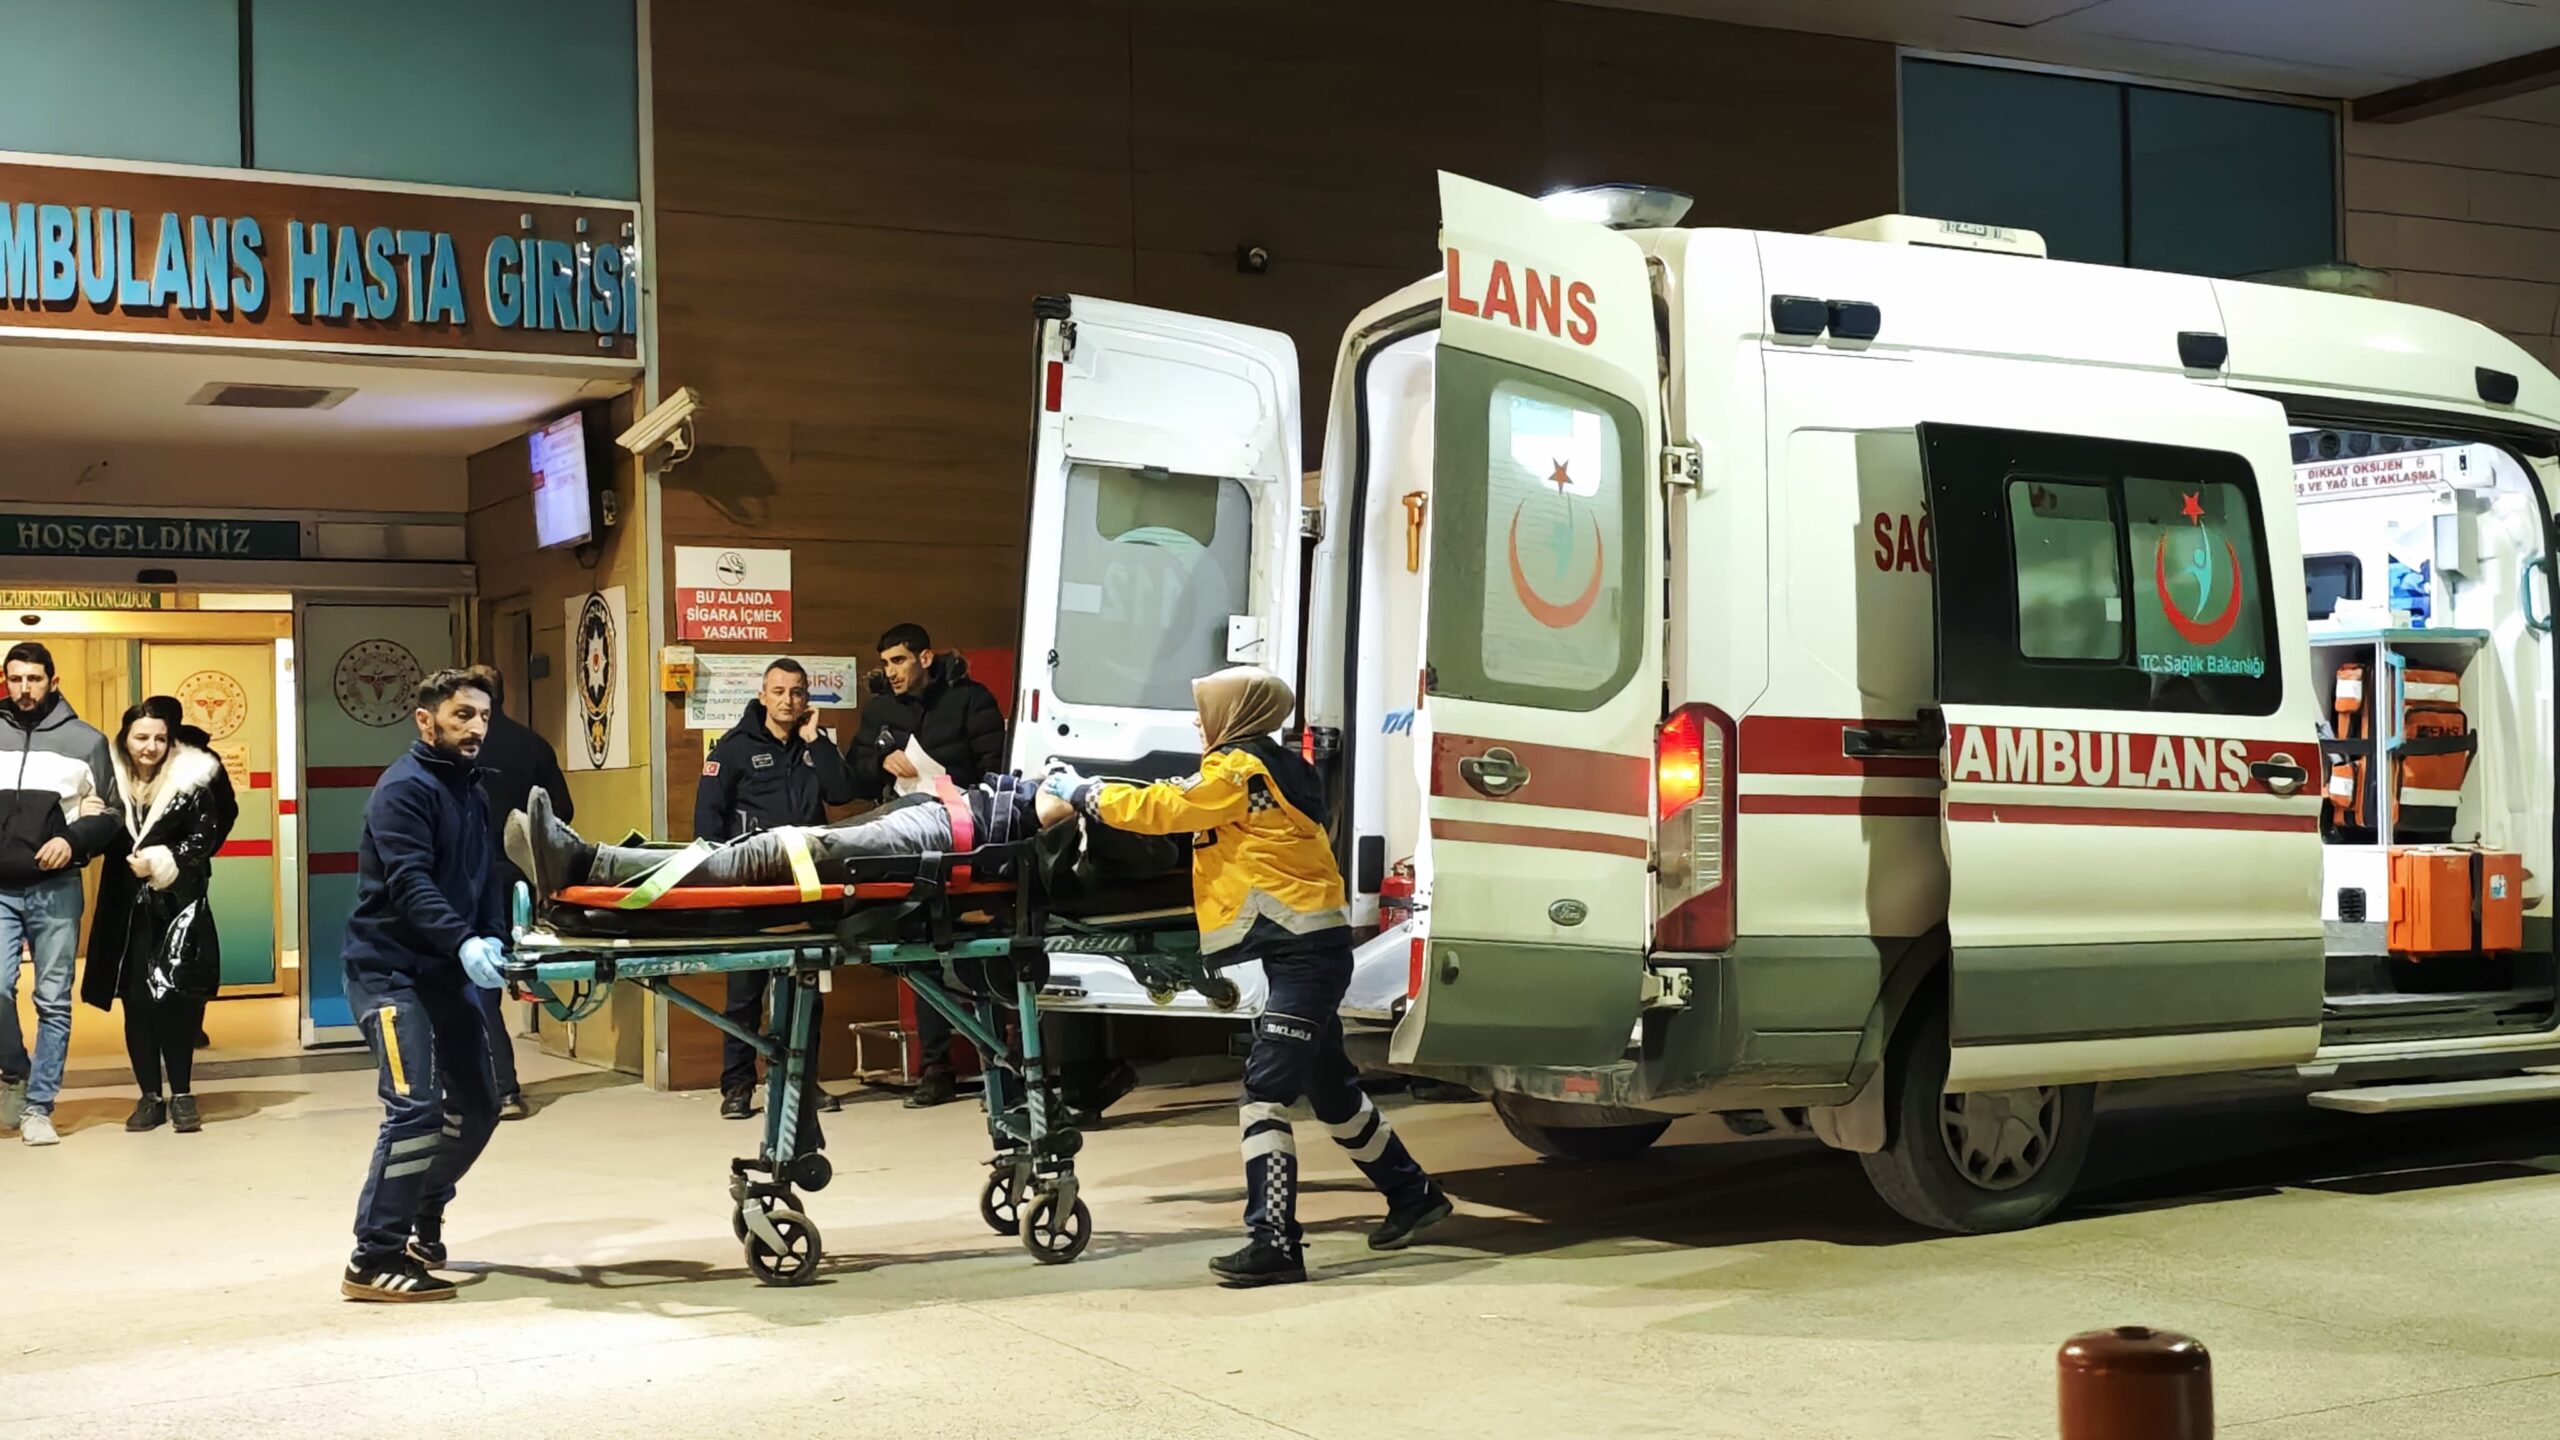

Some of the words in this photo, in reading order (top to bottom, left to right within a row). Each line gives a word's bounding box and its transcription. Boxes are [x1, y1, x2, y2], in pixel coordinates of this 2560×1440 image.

[288, 220, 466, 324] HASTA
[485, 213, 637, 347] GİRİŞİ
[1447, 247, 1598, 346] LANS
[2353, 459, 2403, 475] OKSİJEN
[2308, 481, 2323, 492] VE
[2327, 477, 2348, 490] YAĞ
[2373, 470, 2437, 485] YAKLAŞMA
[17, 521, 250, 554] HOŞGELDİNİZ
[696, 590, 715, 604] BU
[718, 591, 774, 605] ALANDA
[686, 605, 738, 621] SİGARA
[740, 605, 782, 624] İÇMEK
[702, 625, 768, 639] YASAKTIR
[2164, 655, 2203, 677] Sağlık
[2207, 655, 2265, 678] Bakanlığı
[1953, 725, 2250, 792] AMBULANS
